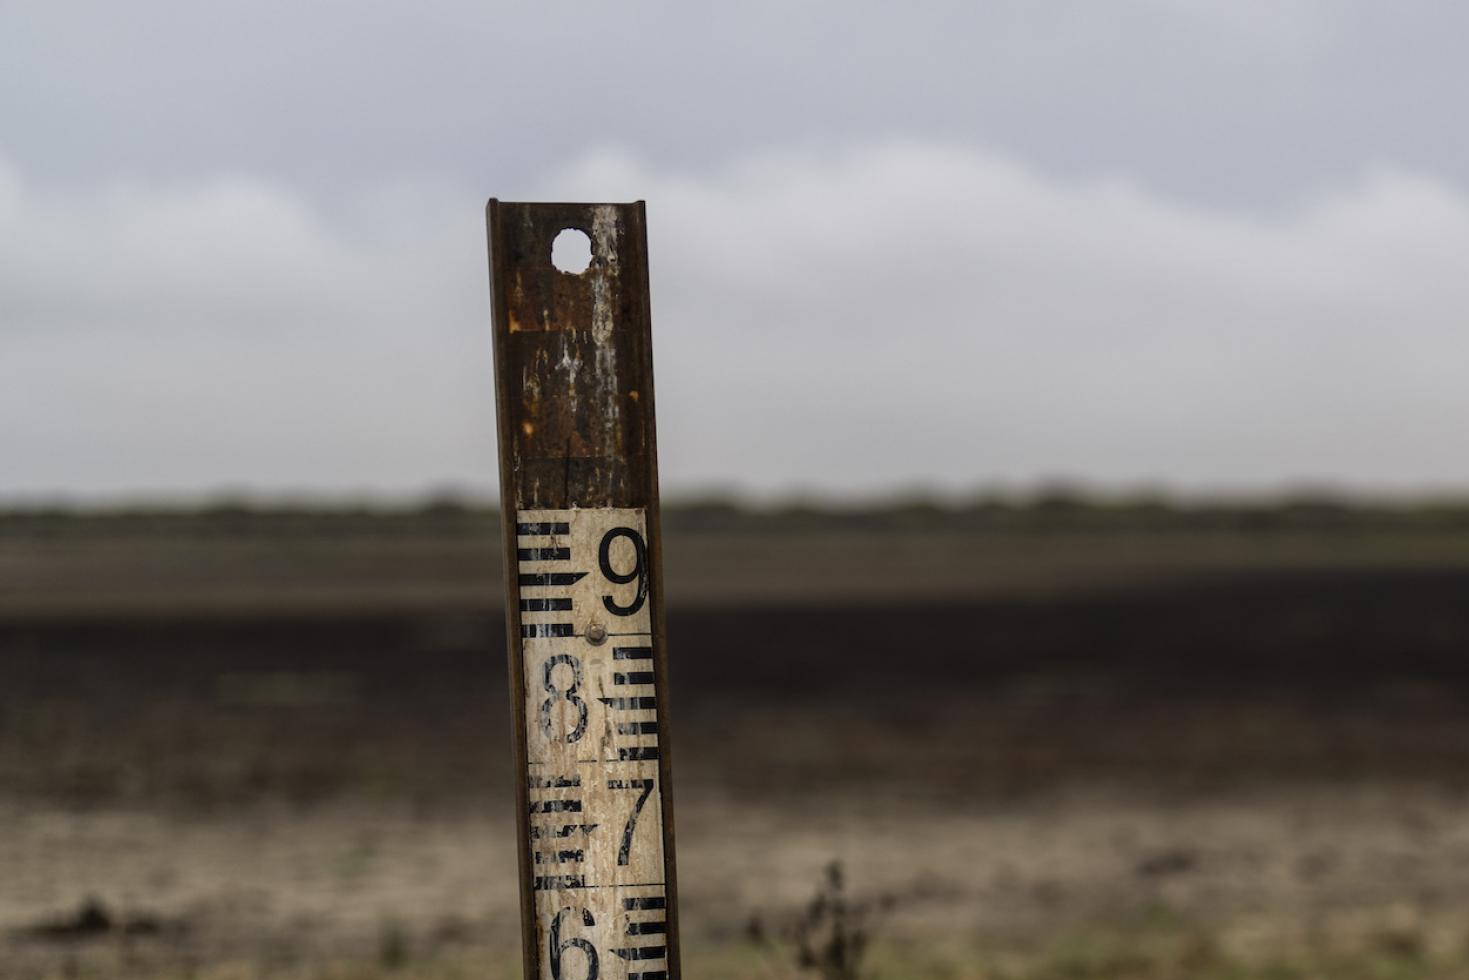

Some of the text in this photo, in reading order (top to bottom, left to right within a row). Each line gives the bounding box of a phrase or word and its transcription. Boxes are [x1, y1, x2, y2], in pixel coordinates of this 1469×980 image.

[598, 526, 649, 617] 9
[540, 653, 589, 745] 8
[607, 778, 655, 867] 7
